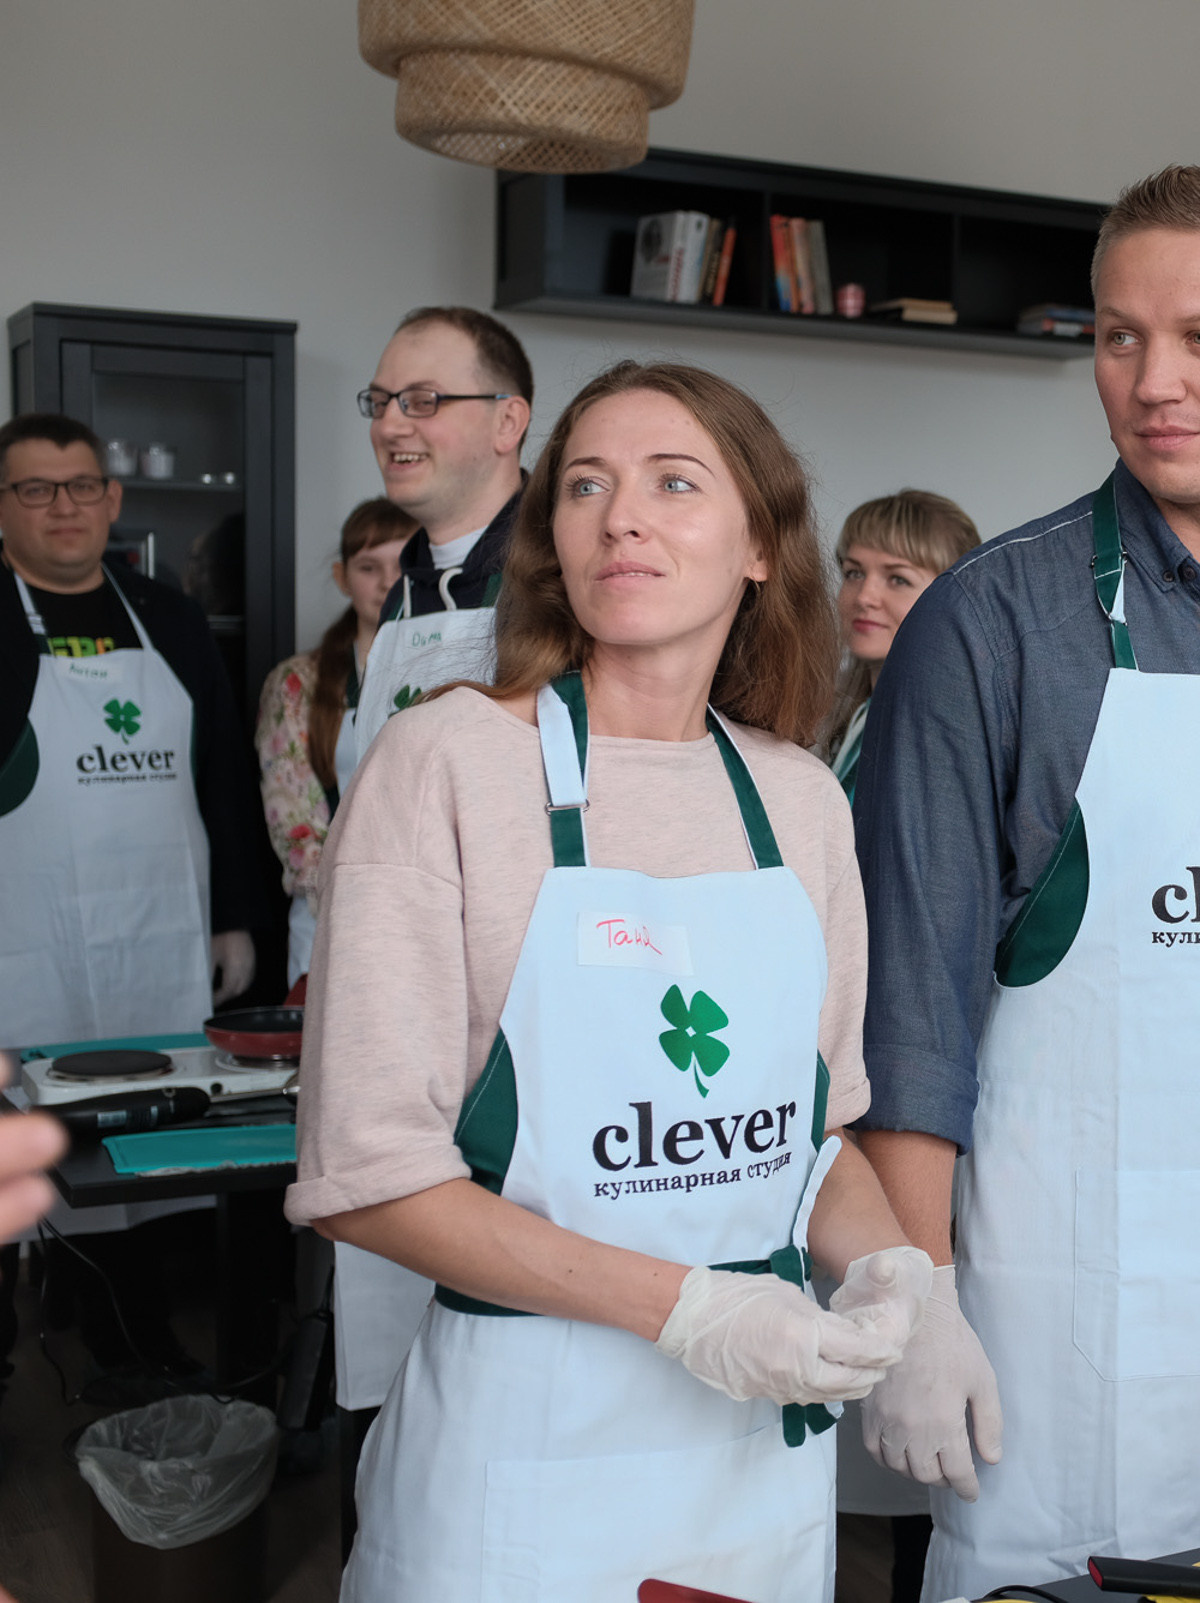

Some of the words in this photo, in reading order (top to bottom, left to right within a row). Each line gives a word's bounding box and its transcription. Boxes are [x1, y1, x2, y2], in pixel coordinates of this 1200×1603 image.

[76, 744, 174, 773] clever
[592, 1100, 797, 1172] clever
[593, 1168, 742, 1200] кулинарная
[746, 1151, 792, 1180] студия
